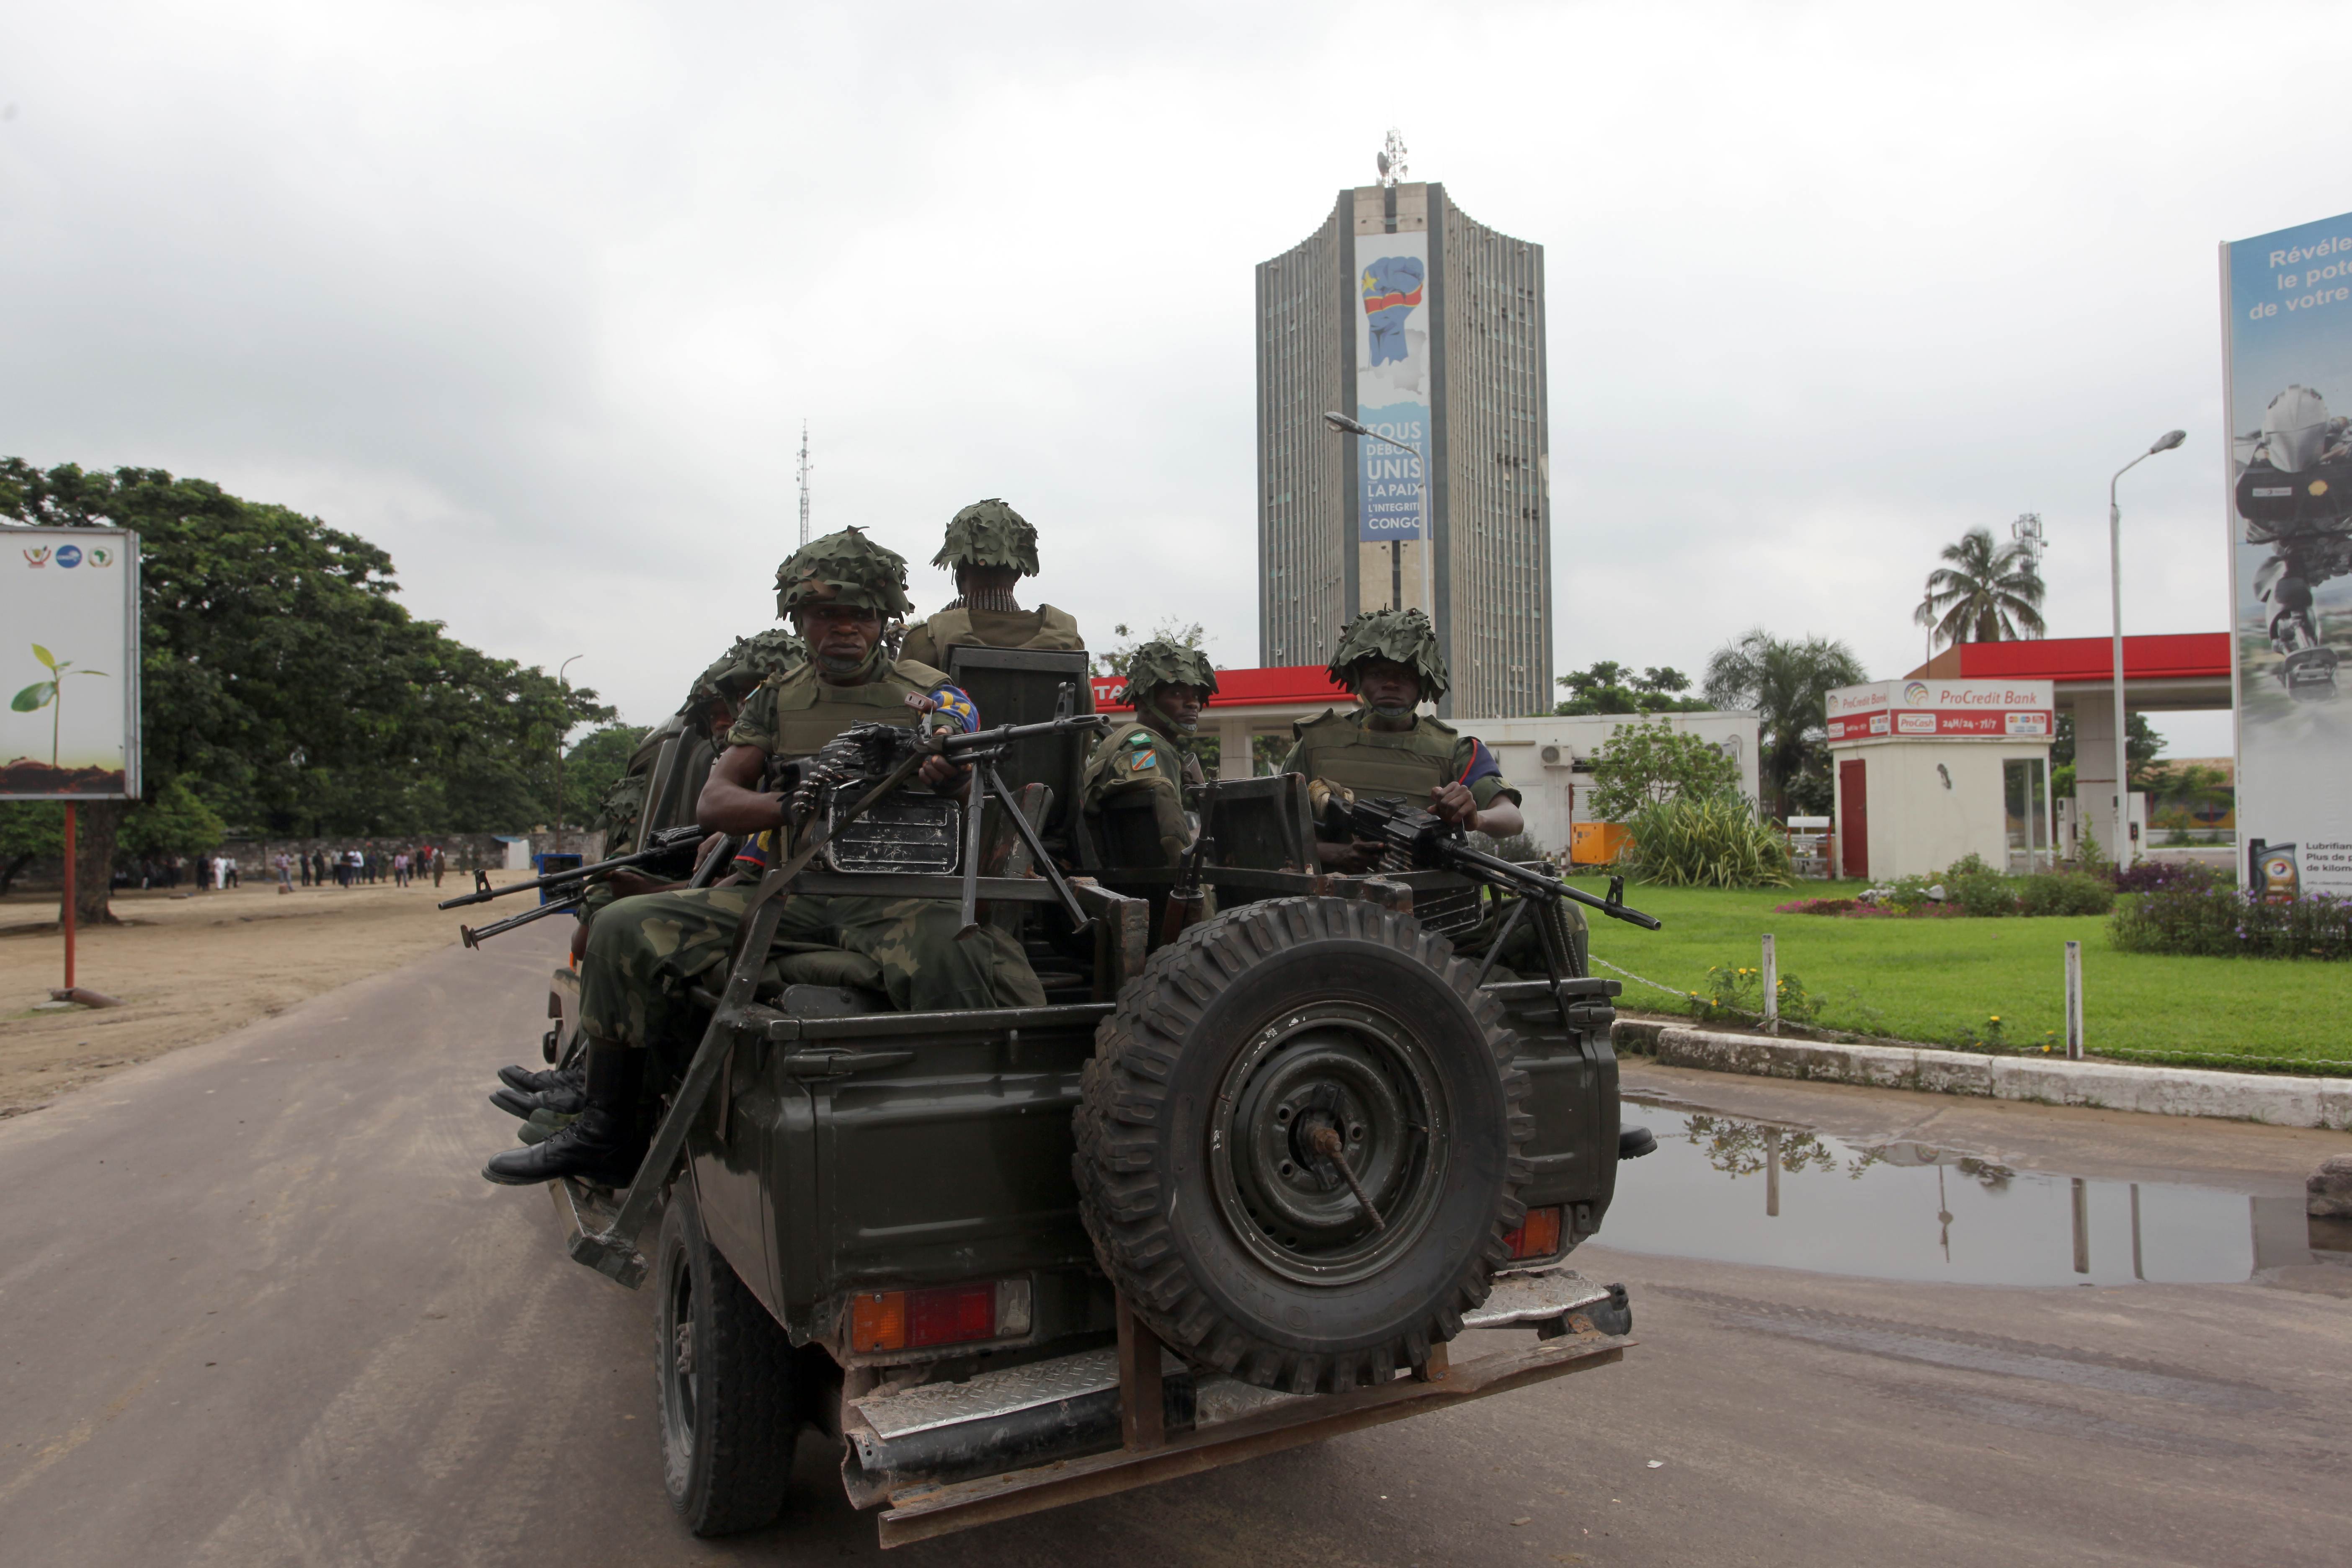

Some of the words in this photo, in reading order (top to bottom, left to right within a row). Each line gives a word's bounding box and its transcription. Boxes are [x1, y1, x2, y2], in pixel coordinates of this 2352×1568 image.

[2277, 274, 2298, 291] le
[2249, 302, 2278, 320] de
[2285, 286, 2349, 312] votre
[1366, 421, 1422, 441] TOUS
[1367, 442, 1421, 456] DEBOUT
[1367, 457, 1421, 480] UNIS
[1368, 485, 1386, 497] LA
[1388, 483, 1419, 496] PAIX
[1843, 696, 1870, 709] ProCredit
[1871, 693, 1887, 704] Bank
[1940, 690, 2001, 704] ProCredit
[2004, 690, 2037, 704] Bank
[1901, 718, 1934, 727] ProCash
[1942, 718, 1974, 729] 24H/24
